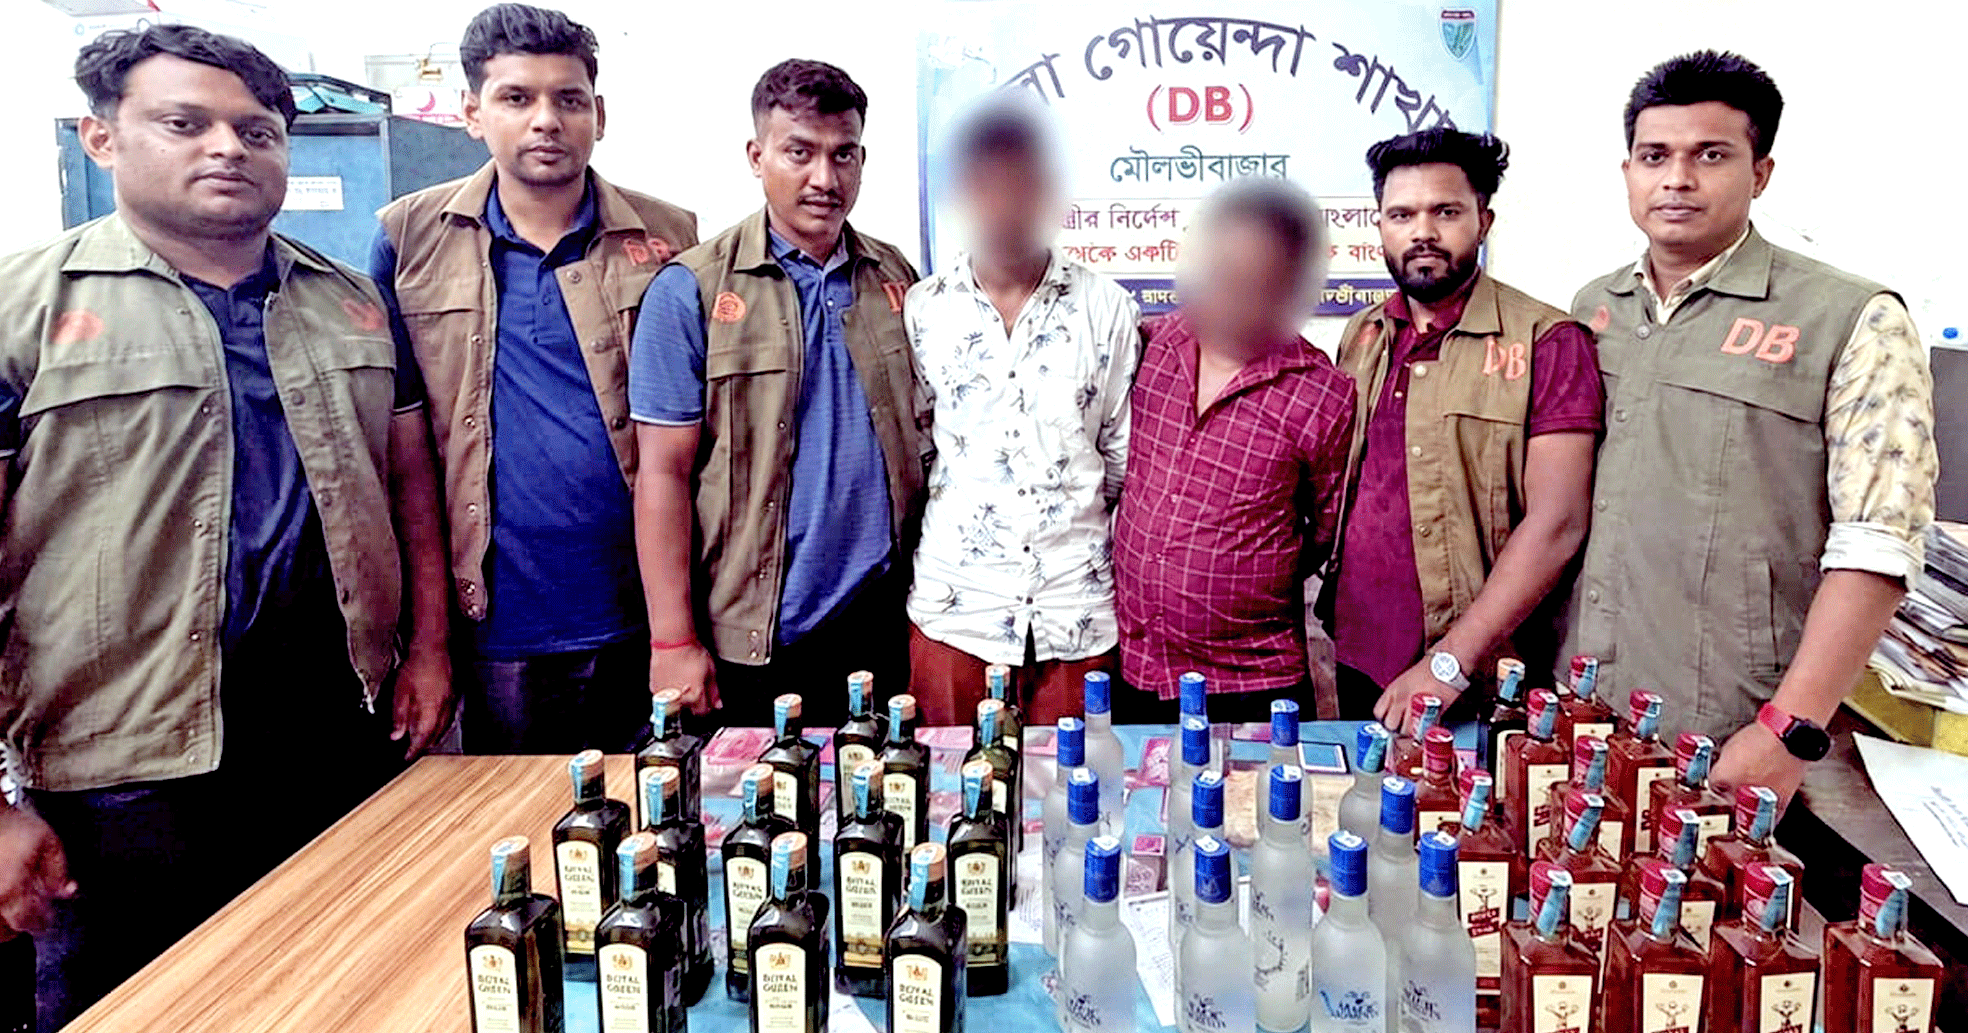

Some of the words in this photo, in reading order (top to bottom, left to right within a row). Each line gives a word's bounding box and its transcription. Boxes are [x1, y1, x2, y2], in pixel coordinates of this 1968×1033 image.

[1084, 14, 1317, 81] গোয়েন্দা
[1147, 83, 1254, 135] (DB)
[1110, 144, 1291, 182] মৌলভীবাজার
[1482, 334, 1527, 380] DB
[1721, 317, 1800, 363] DB
